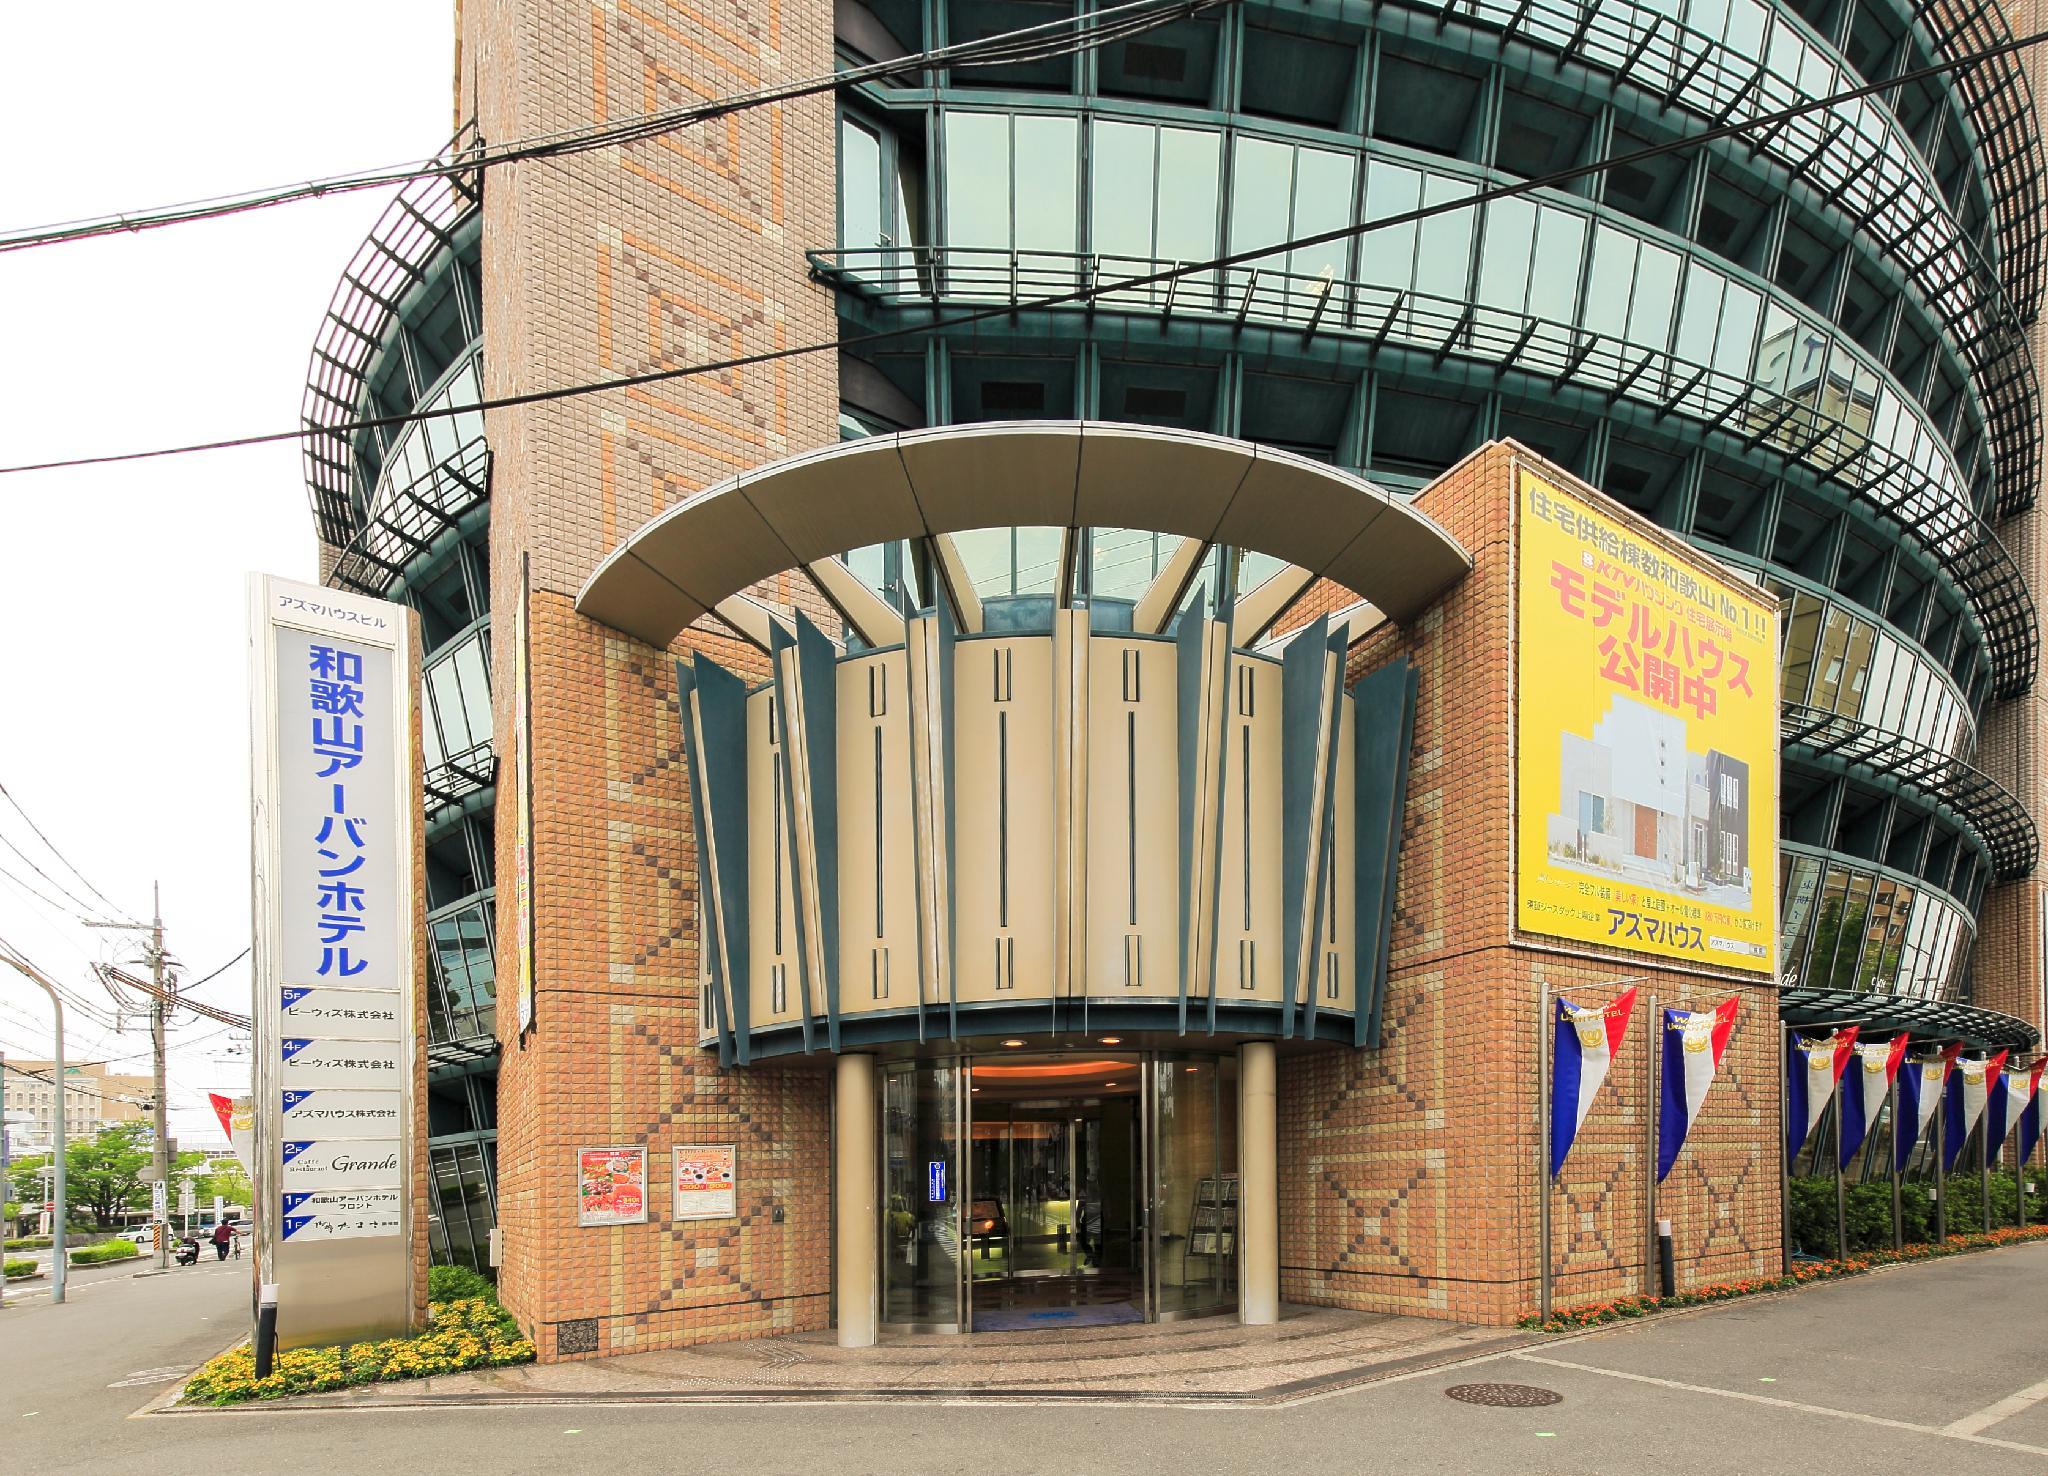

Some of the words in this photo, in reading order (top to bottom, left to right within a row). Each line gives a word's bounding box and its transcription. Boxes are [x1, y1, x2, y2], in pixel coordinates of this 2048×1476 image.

[278, 595, 388, 628] アズマハウスビル
[1550, 559, 1753, 699] モデルハウス
[1598, 634, 1717, 721] 公開中
[309, 644, 369, 977] 和歌山アーバンホテル
[1607, 908, 1705, 952] アズマハウス
[283, 989, 301, 1000] 5F
[288, 1007, 394, 1020] ビーウィズ株式会社
[283, 1041, 301, 1052] 4F
[288, 1058, 395, 1070] ビーウィズ株式会社
[284, 1092, 302, 1103] 3F
[291, 1109, 397, 1119] アズマハウス株式会社
[285, 1143, 302, 1154] 2F
[331, 1153, 398, 1173] Grande
[285, 1195, 302, 1205] 1F
[311, 1194, 399, 1204] 和歌山アーバンホテル
[285, 1219, 302, 1230] 1F
